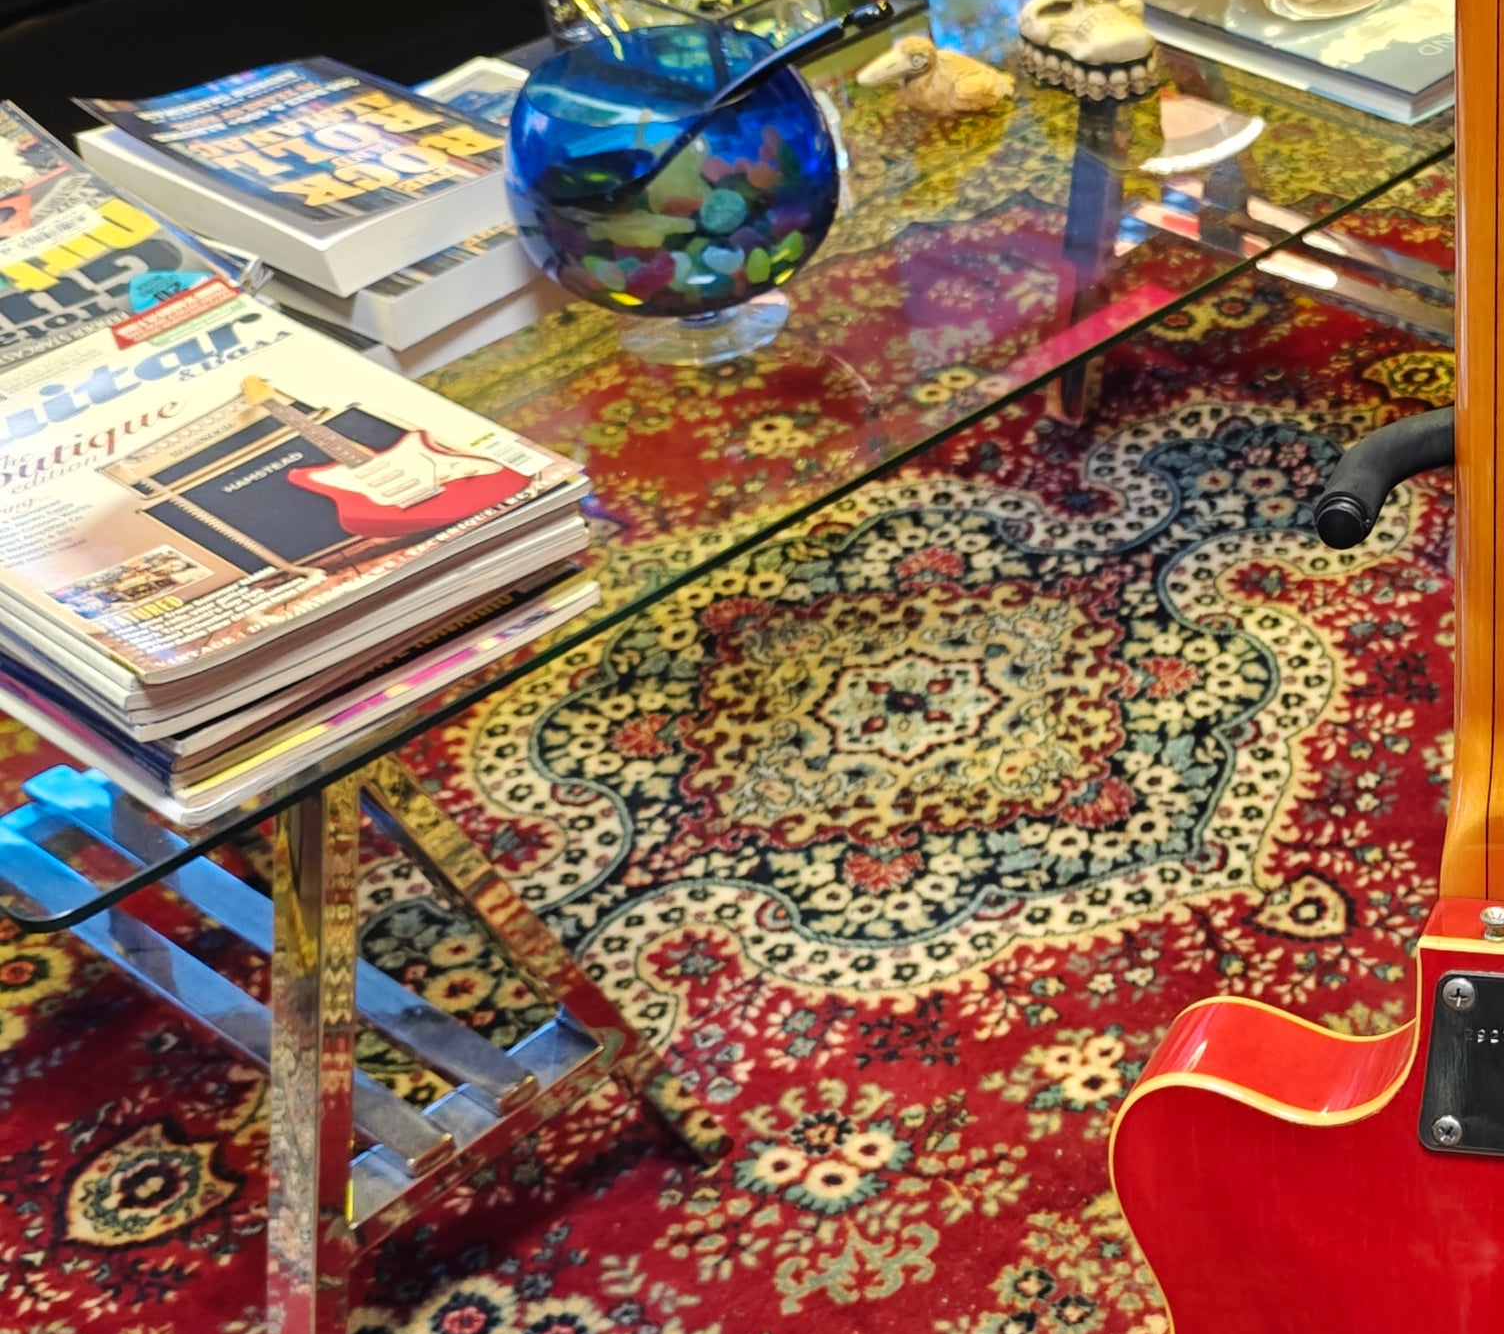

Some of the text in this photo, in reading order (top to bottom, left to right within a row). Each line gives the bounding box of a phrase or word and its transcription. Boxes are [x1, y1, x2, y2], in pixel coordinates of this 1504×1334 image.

[212, 100, 445, 178] ROLL
[269, 124, 505, 208] ROCK
[0, 312, 263, 449] uitar
[220, 450, 304, 496] HAMSTEAD
